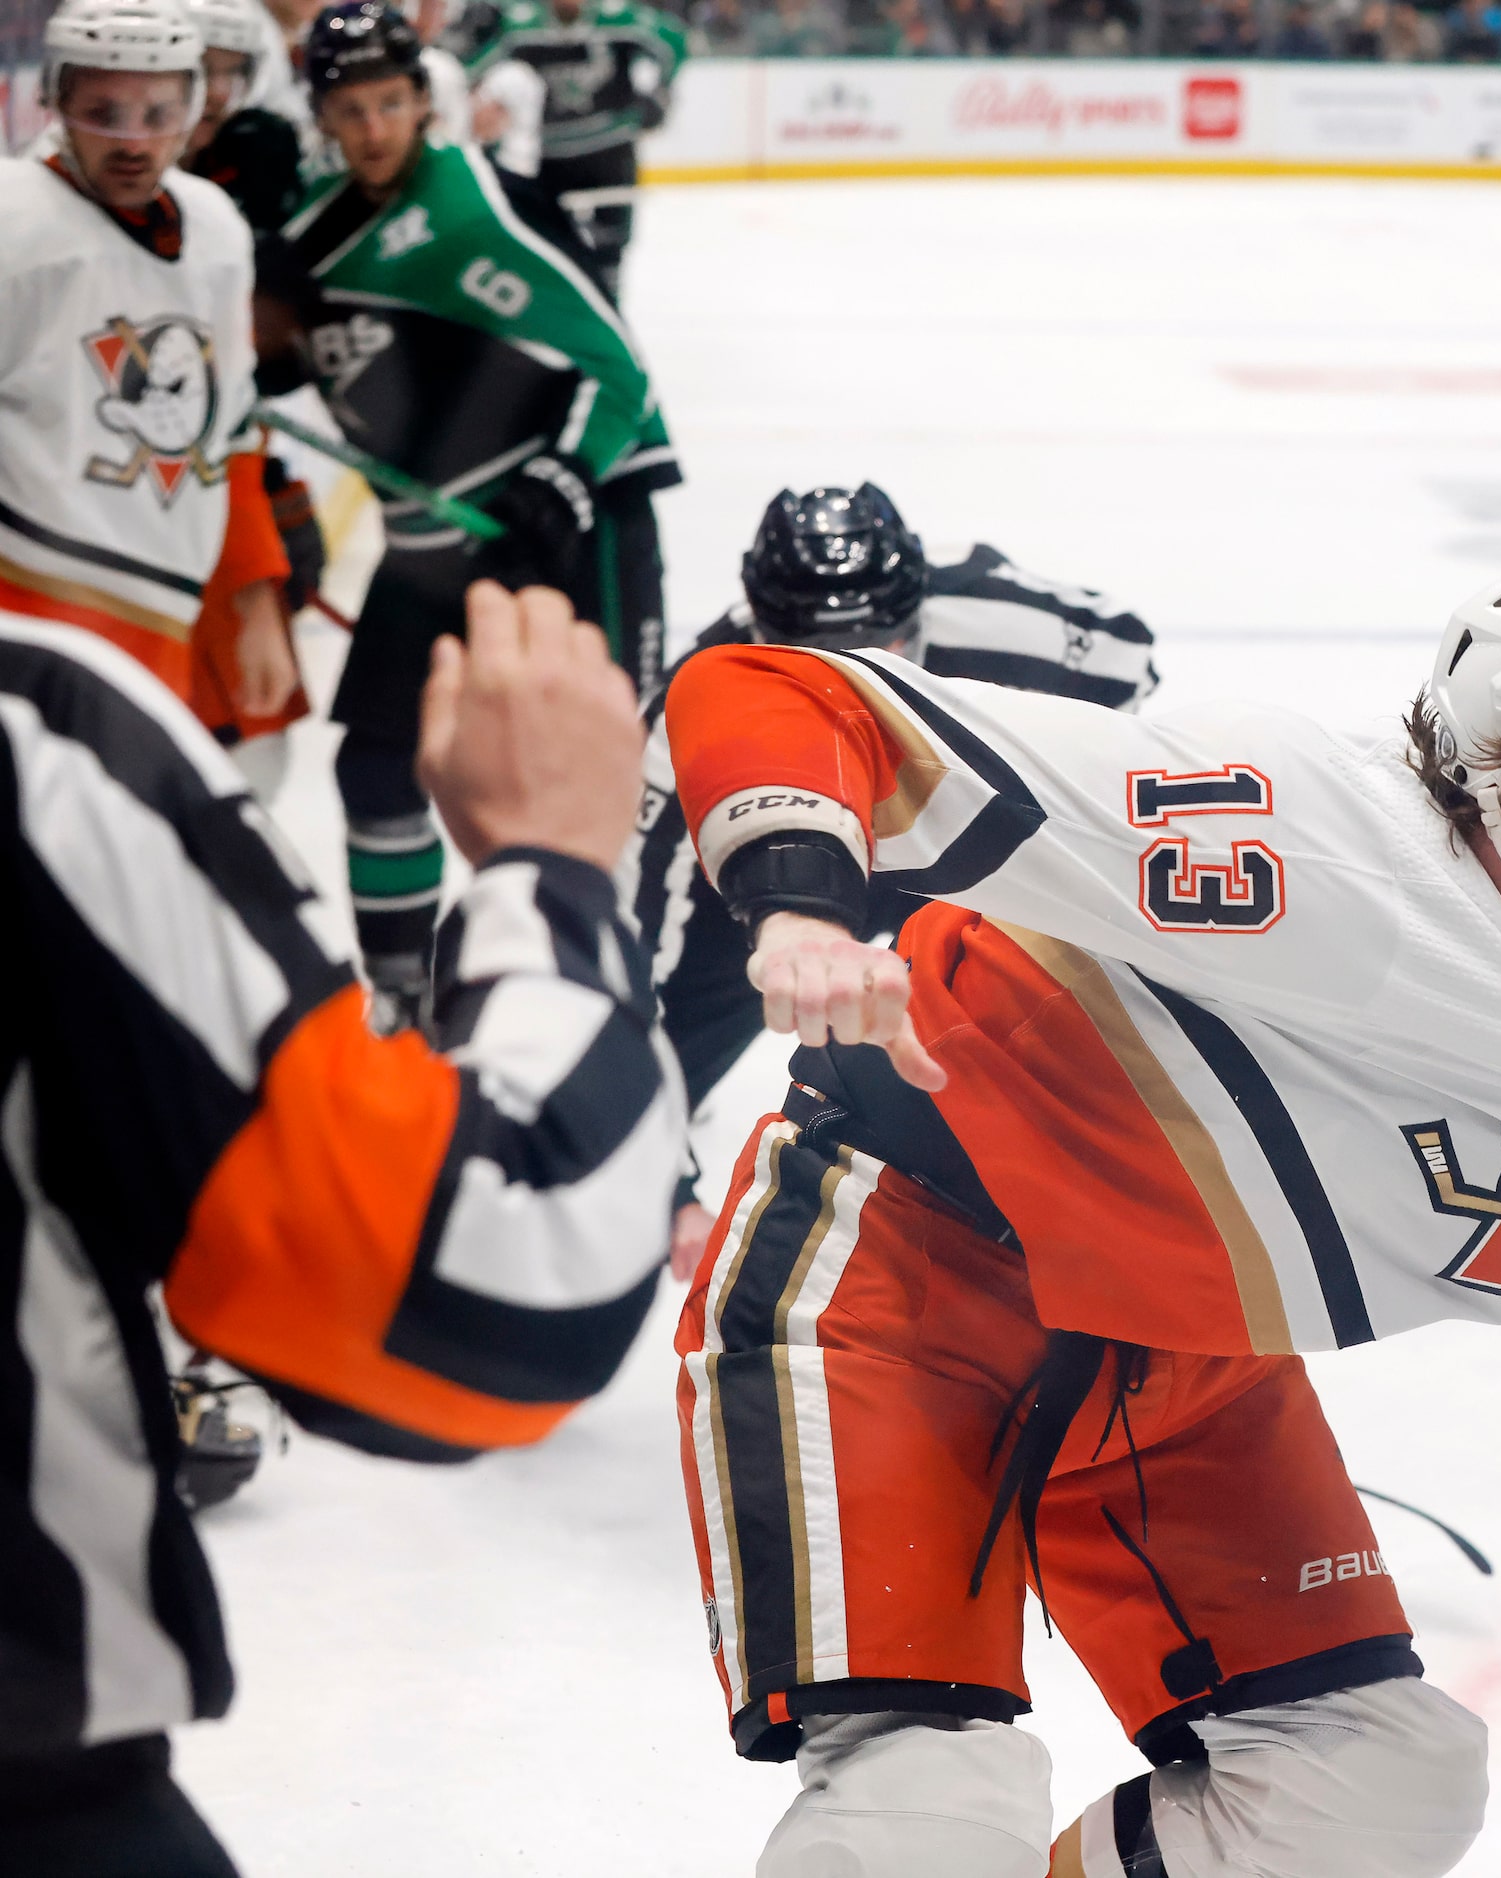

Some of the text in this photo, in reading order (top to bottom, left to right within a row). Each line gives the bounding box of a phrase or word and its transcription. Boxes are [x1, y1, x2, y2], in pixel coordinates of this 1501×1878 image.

[459, 256, 532, 319] 6
[728, 795, 820, 821] CCM
[1126, 763, 1286, 935] 13
